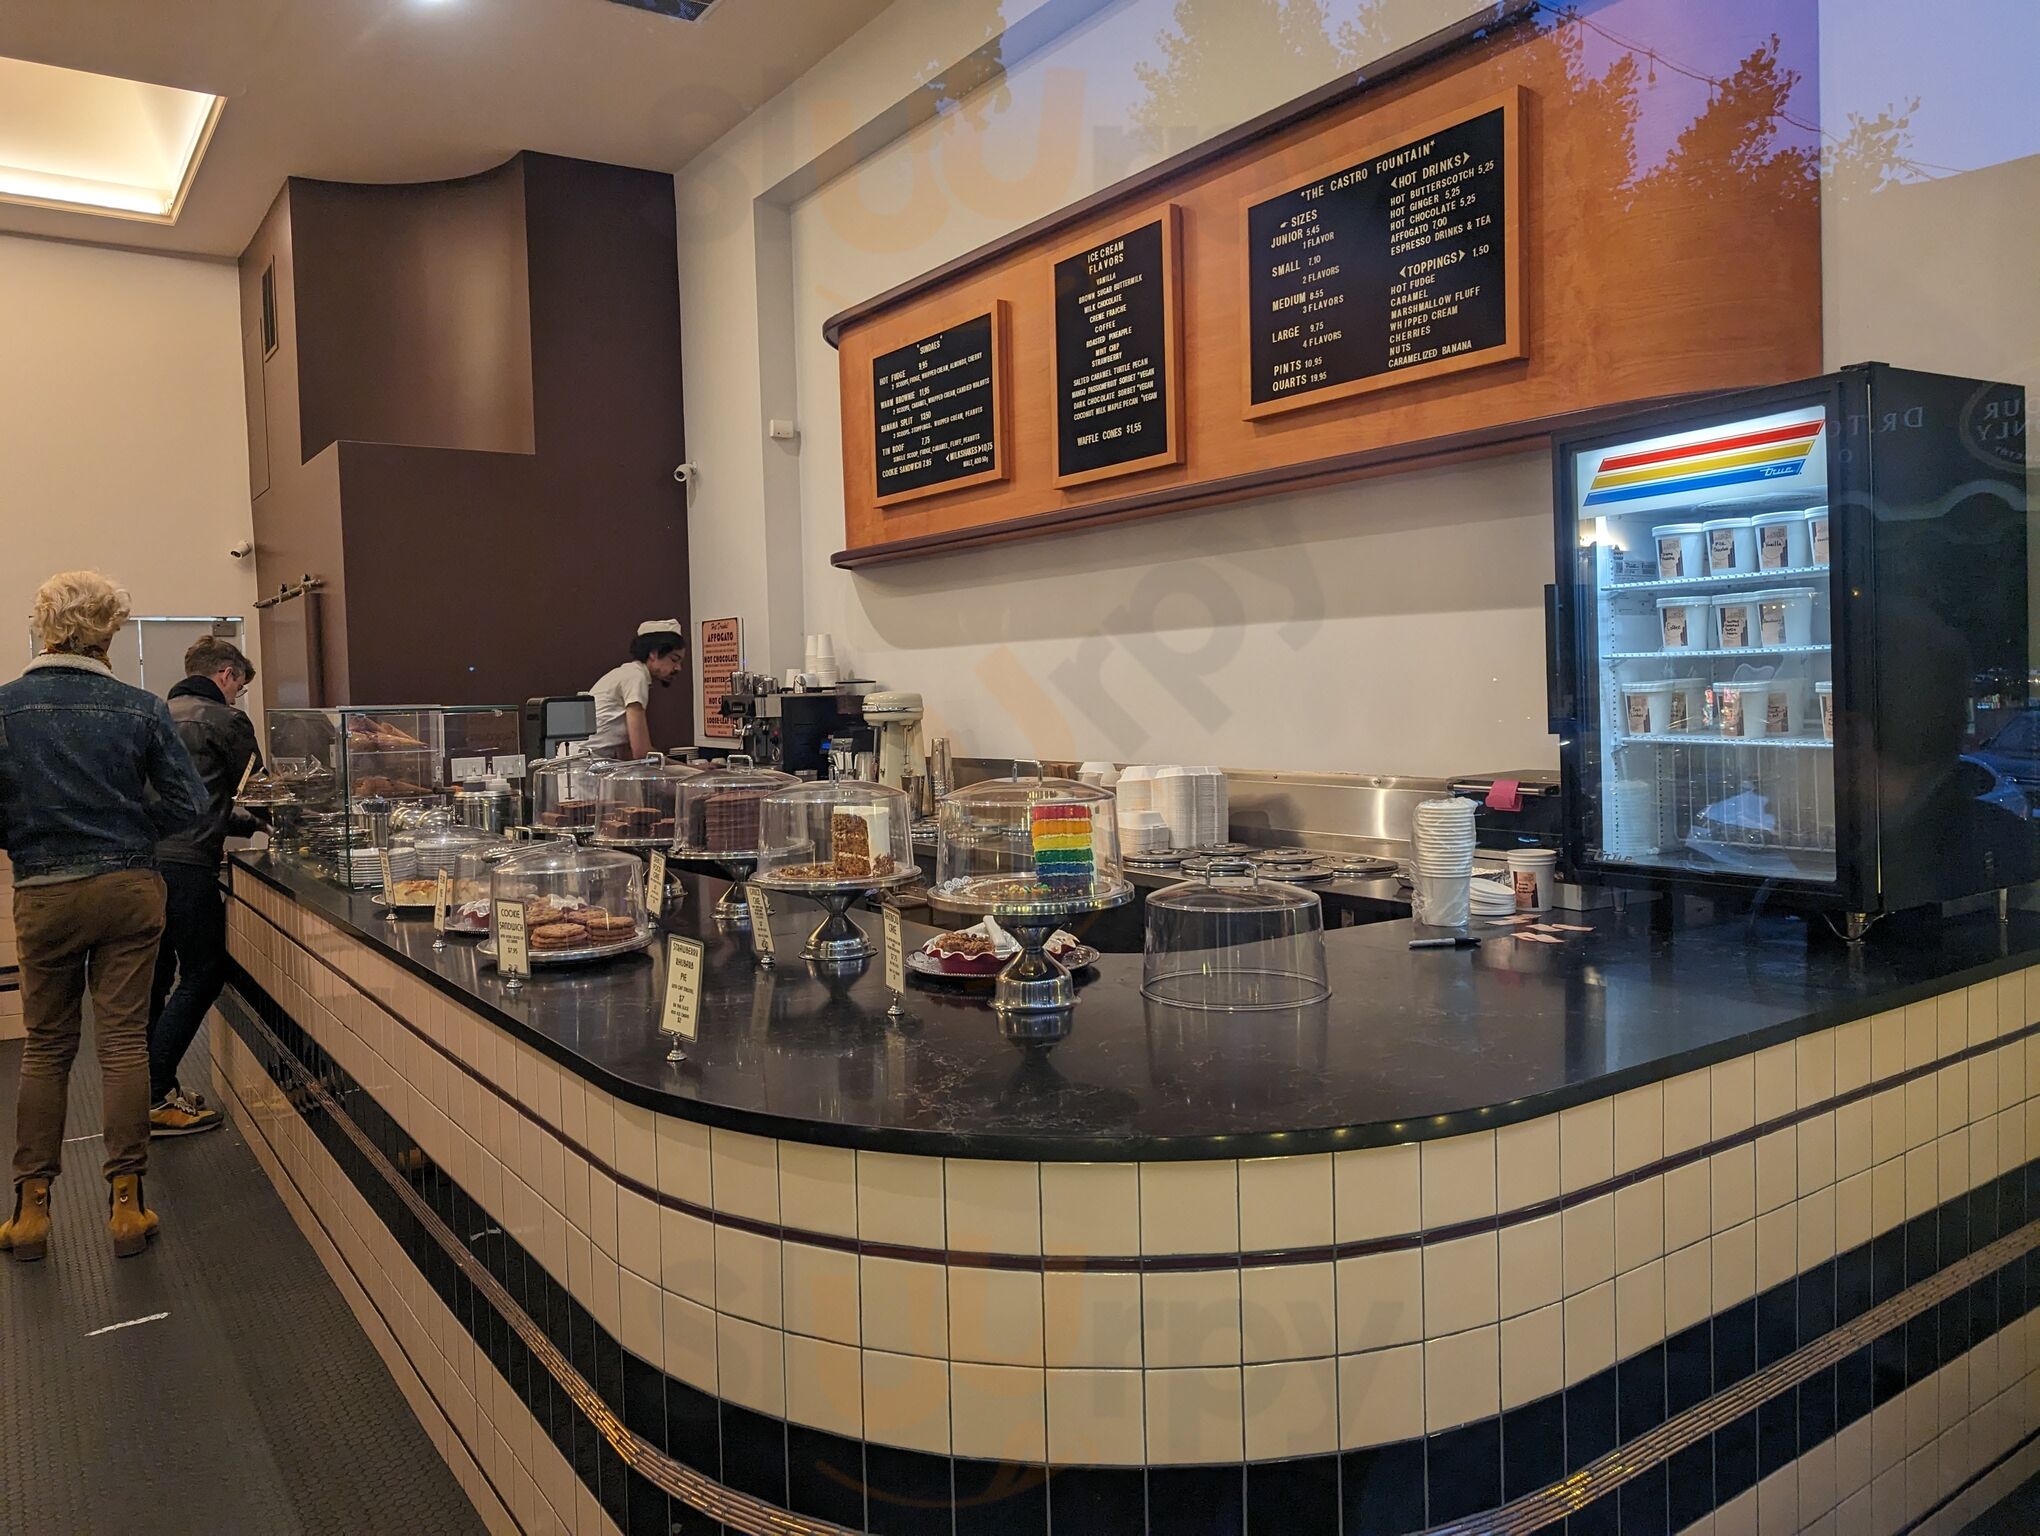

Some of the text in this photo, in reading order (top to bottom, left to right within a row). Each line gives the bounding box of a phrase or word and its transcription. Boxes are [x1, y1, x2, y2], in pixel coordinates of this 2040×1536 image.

[1305, 143, 1430, 201] THE CASTRO FOUNTAIN
[1399, 155, 1461, 188] HOT DRINKS
[1390, 193, 1406, 207] HOT
[1410, 167, 1475, 199] BUTTERSCOTCH
[1390, 206, 1406, 219] HOT
[1409, 194, 1440, 212] GINGER
[1390, 218, 1406, 231] HOT
[1409, 200, 1457, 225] CHOCOLATE
[1291, 209, 1318, 227] SIZES
[1270, 229, 1303, 249] JUNIOR
[1307, 231, 1335, 248] FLAVOR
[1390, 223, 1429, 244] AFFOGATO
[1391, 214, 1492, 256] ESPRESSO DRINKS & TEA
[1088, 240, 1124, 263] ICE CREAM
[1089, 253, 1124, 275] FLAVORS
[1272, 260, 1301, 277] SMALL
[1407, 252, 1457, 277] TOPPINGS
[1096, 272, 1116, 286] VANILLA
[1302, 265, 1340, 284] 2 FLAVORS
[1078, 273, 1143, 304] BROWN SUGAR BUTTERMILK
[1390, 274, 1436, 295] HOT FUDGE
[1084, 293, 1122, 314] MILK CHOCOLATE
[1272, 292, 1306, 312] MEDIUM
[1302, 294, 1344, 314] 3 FLAVORS
[1390, 289, 1429, 307] CARAMEL
[1391, 285, 1480, 320] MARSHMALLOW FLUFF
[1089, 304, 1127, 323] CREME FRAICHE
[1390, 305, 1458, 332] WHIPPED CREAM
[1094, 320, 1115, 333] COFFEE
[1272, 326, 1300, 343] LARGE
[1389, 325, 1431, 344] CHERRIES
[1086, 326, 1132, 348] ROASTED PINEAPPLE
[1302, 331, 1342, 348] 4 FLAVORS
[967, 352, 983, 362] CHERRY
[1095, 343, 1120, 357] MINT CHIP
[1388, 339, 1472, 368] CARAMELIZED BANANA
[1390, 343, 1411, 357] NUTS
[1091, 352, 1122, 368] STRAWBERRY
[1273, 360, 1302, 376] PINTS
[880, 376, 889, 386] HOT
[891, 370, 906, 382] FUDGE
[1073, 357, 1149, 387] SALTED CARAMEL TURTLE PECAN
[1071, 388, 1086, 399] MANGO
[1087, 379, 1117, 394] PASSIONFRUIT
[1119, 373, 1136, 385] SORBET
[1272, 374, 1307, 392] QUARTS
[880, 399, 894, 409] WARM
[895, 391, 916, 405] BROWNIE
[1073, 400, 1086, 410] DARK
[1087, 392, 1115, 406] CHOCOLATE
[1118, 386, 1136, 397] SORBET
[965, 406, 983, 417] PEANUTS
[1073, 409, 1094, 421] COCONUT
[1095, 406, 1107, 416] MILK
[1107, 401, 1123, 412] MAPLE
[1122, 397, 1139, 408] PECAN
[880, 416, 913, 433] BANANA SPLIT
[1077, 427, 1122, 447] WAFFLE CONES
[892, 443, 905, 454] ROOF
[950, 446, 978, 461] MILKSHAKES
[882, 466, 899, 478] COOKIE
[899, 460, 922, 474] SANDWICH
[707, 631, 734, 643] AFFOGATO
[704, 654, 738, 664] HOT CHOCOLATE
[501, 908, 520, 919] COOKIE
[499, 921, 523, 932] SANDWICH
[675, 957, 694, 970] RHUBARB
